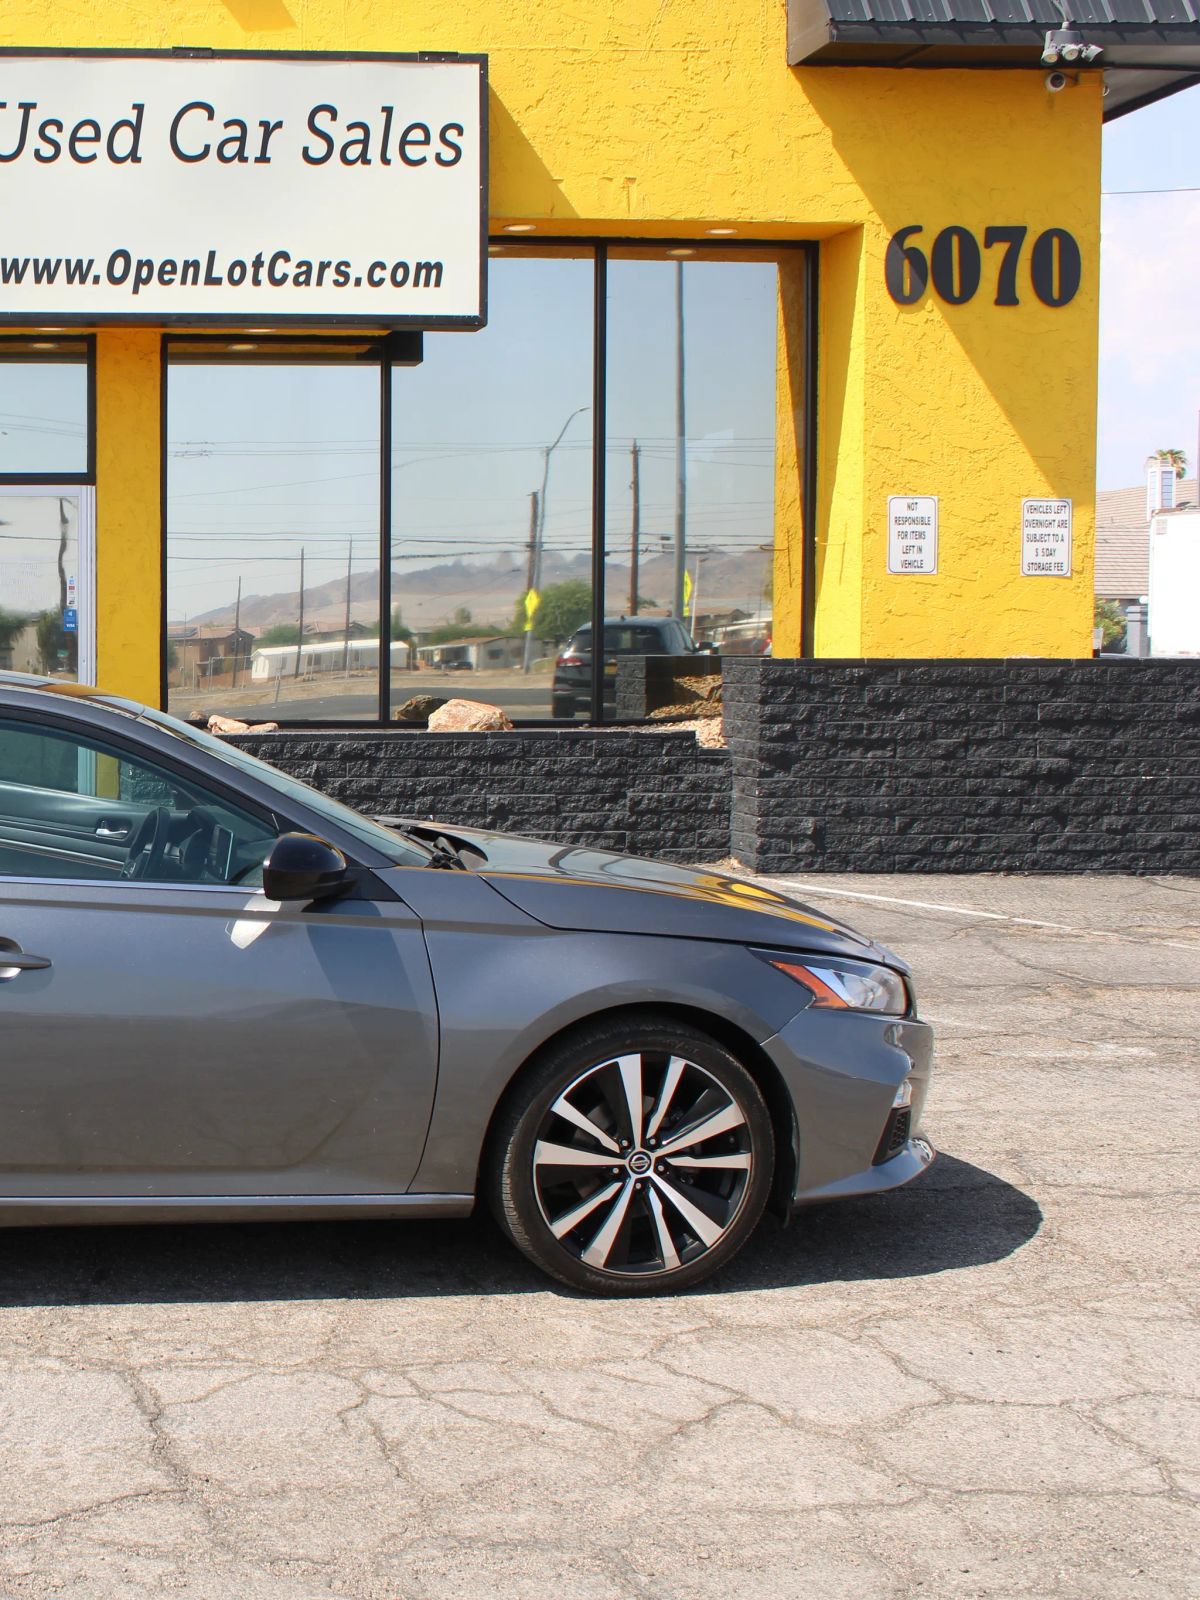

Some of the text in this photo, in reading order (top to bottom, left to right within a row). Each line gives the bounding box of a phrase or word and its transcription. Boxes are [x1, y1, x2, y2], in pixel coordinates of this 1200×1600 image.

[169, 101, 285, 164] Car
[301, 103, 464, 168] Sales
[0, 248, 444, 295] www.OpenLotCars.com
[884, 225, 1082, 309] 6070
[907, 502, 918, 511] NOT
[1026, 504, 1067, 514] VEHICLES LEFT
[894, 516, 931, 525] RESPONSIBLE
[1025, 519, 1068, 529] OVERNIGHT ARE
[897, 531, 926, 540] FOR ITEMS
[1026, 534, 1051, 543] SUBJECT
[1052, 534, 1059, 543] TO
[902, 545, 923, 554] LEFT IN
[901, 560, 923, 569] VEHICLE
[1027, 562, 1064, 572] STORAGE FEE
